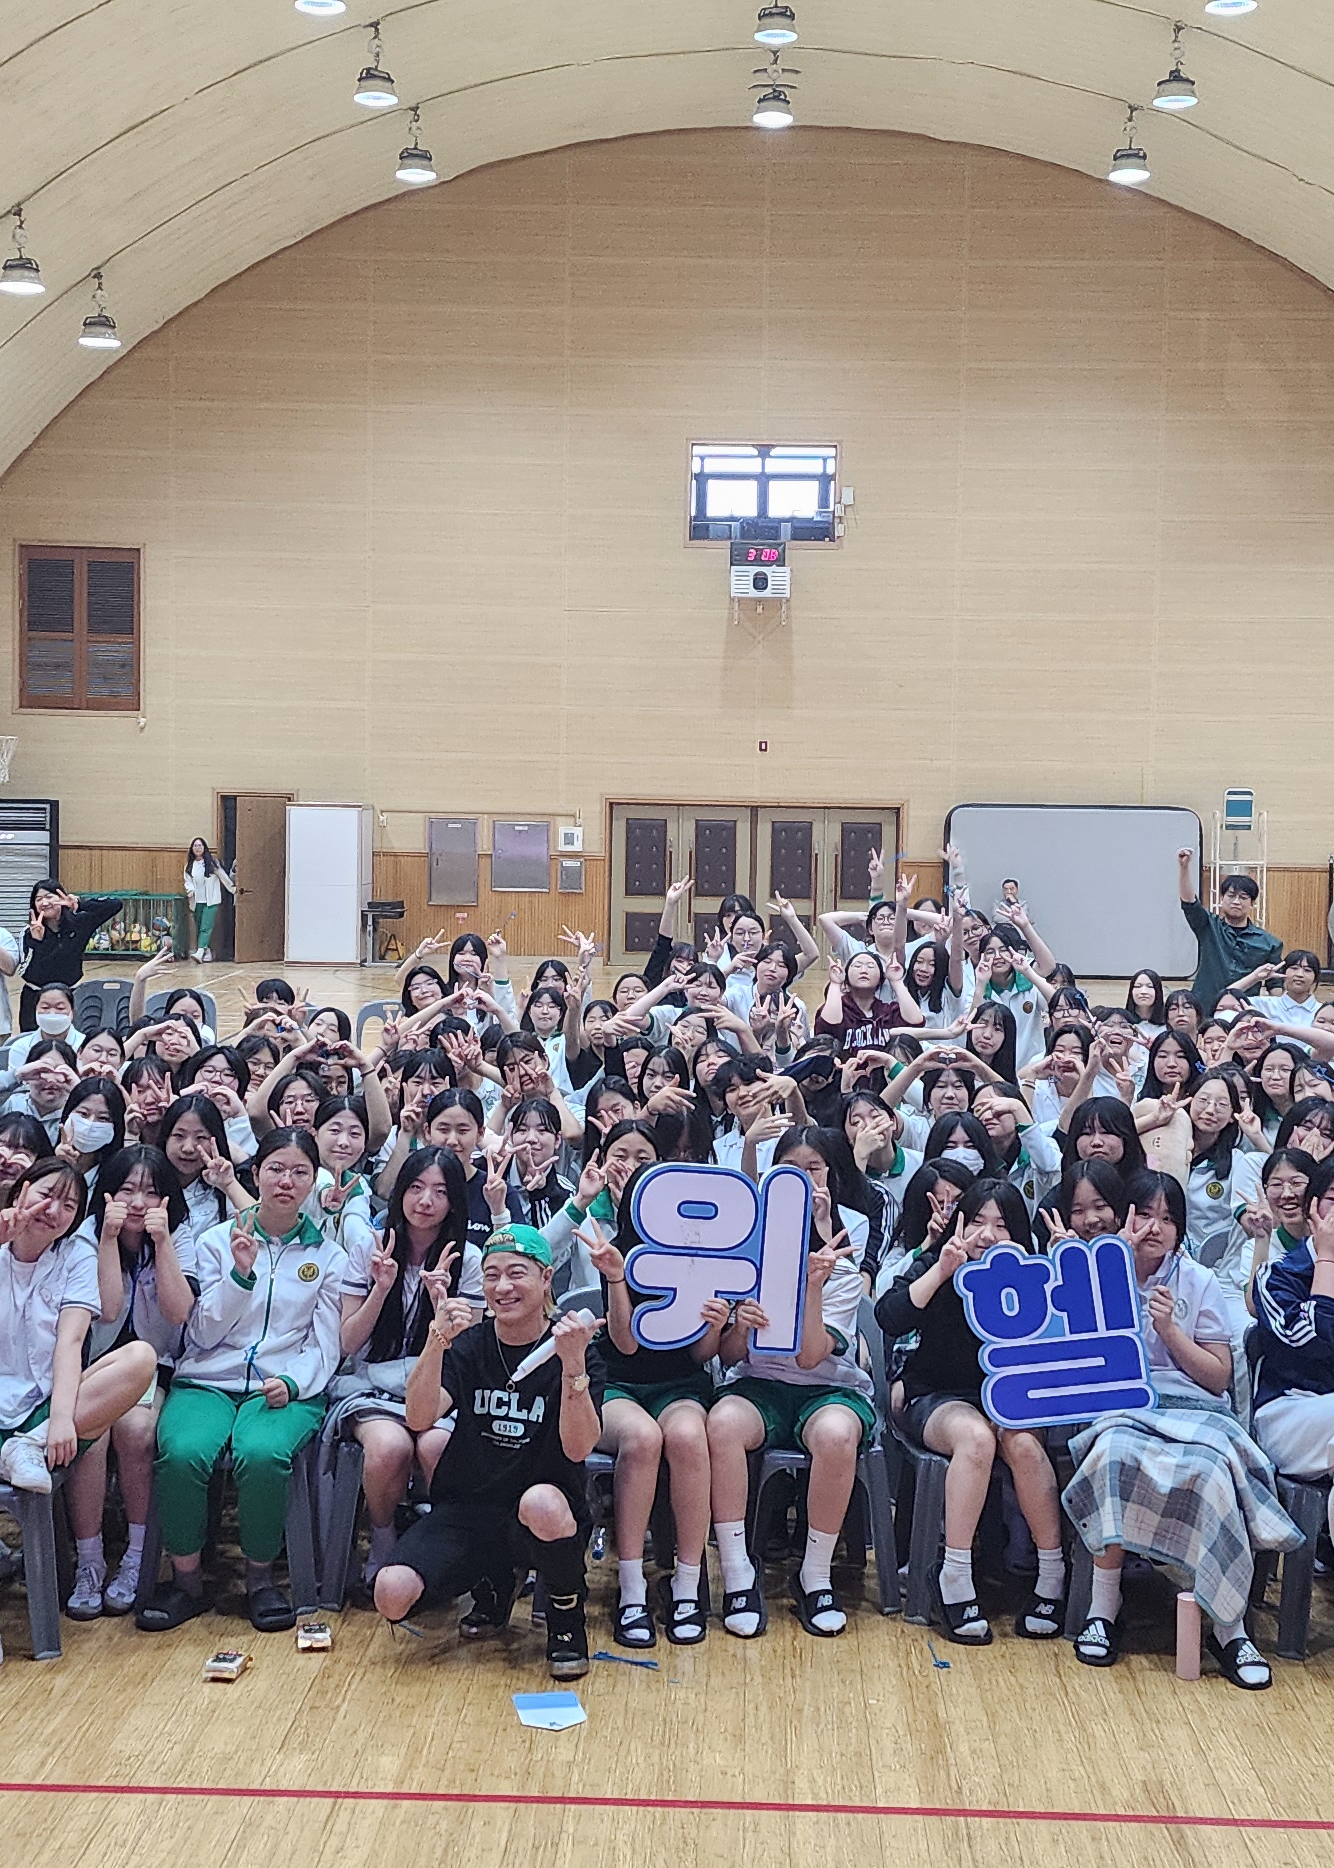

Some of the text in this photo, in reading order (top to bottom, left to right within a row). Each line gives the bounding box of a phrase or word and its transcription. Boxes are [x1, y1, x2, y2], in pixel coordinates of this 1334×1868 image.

[630, 1168, 809, 1351] 위
[961, 1241, 1151, 1421] 헬
[473, 1389, 546, 1423] UCLA
